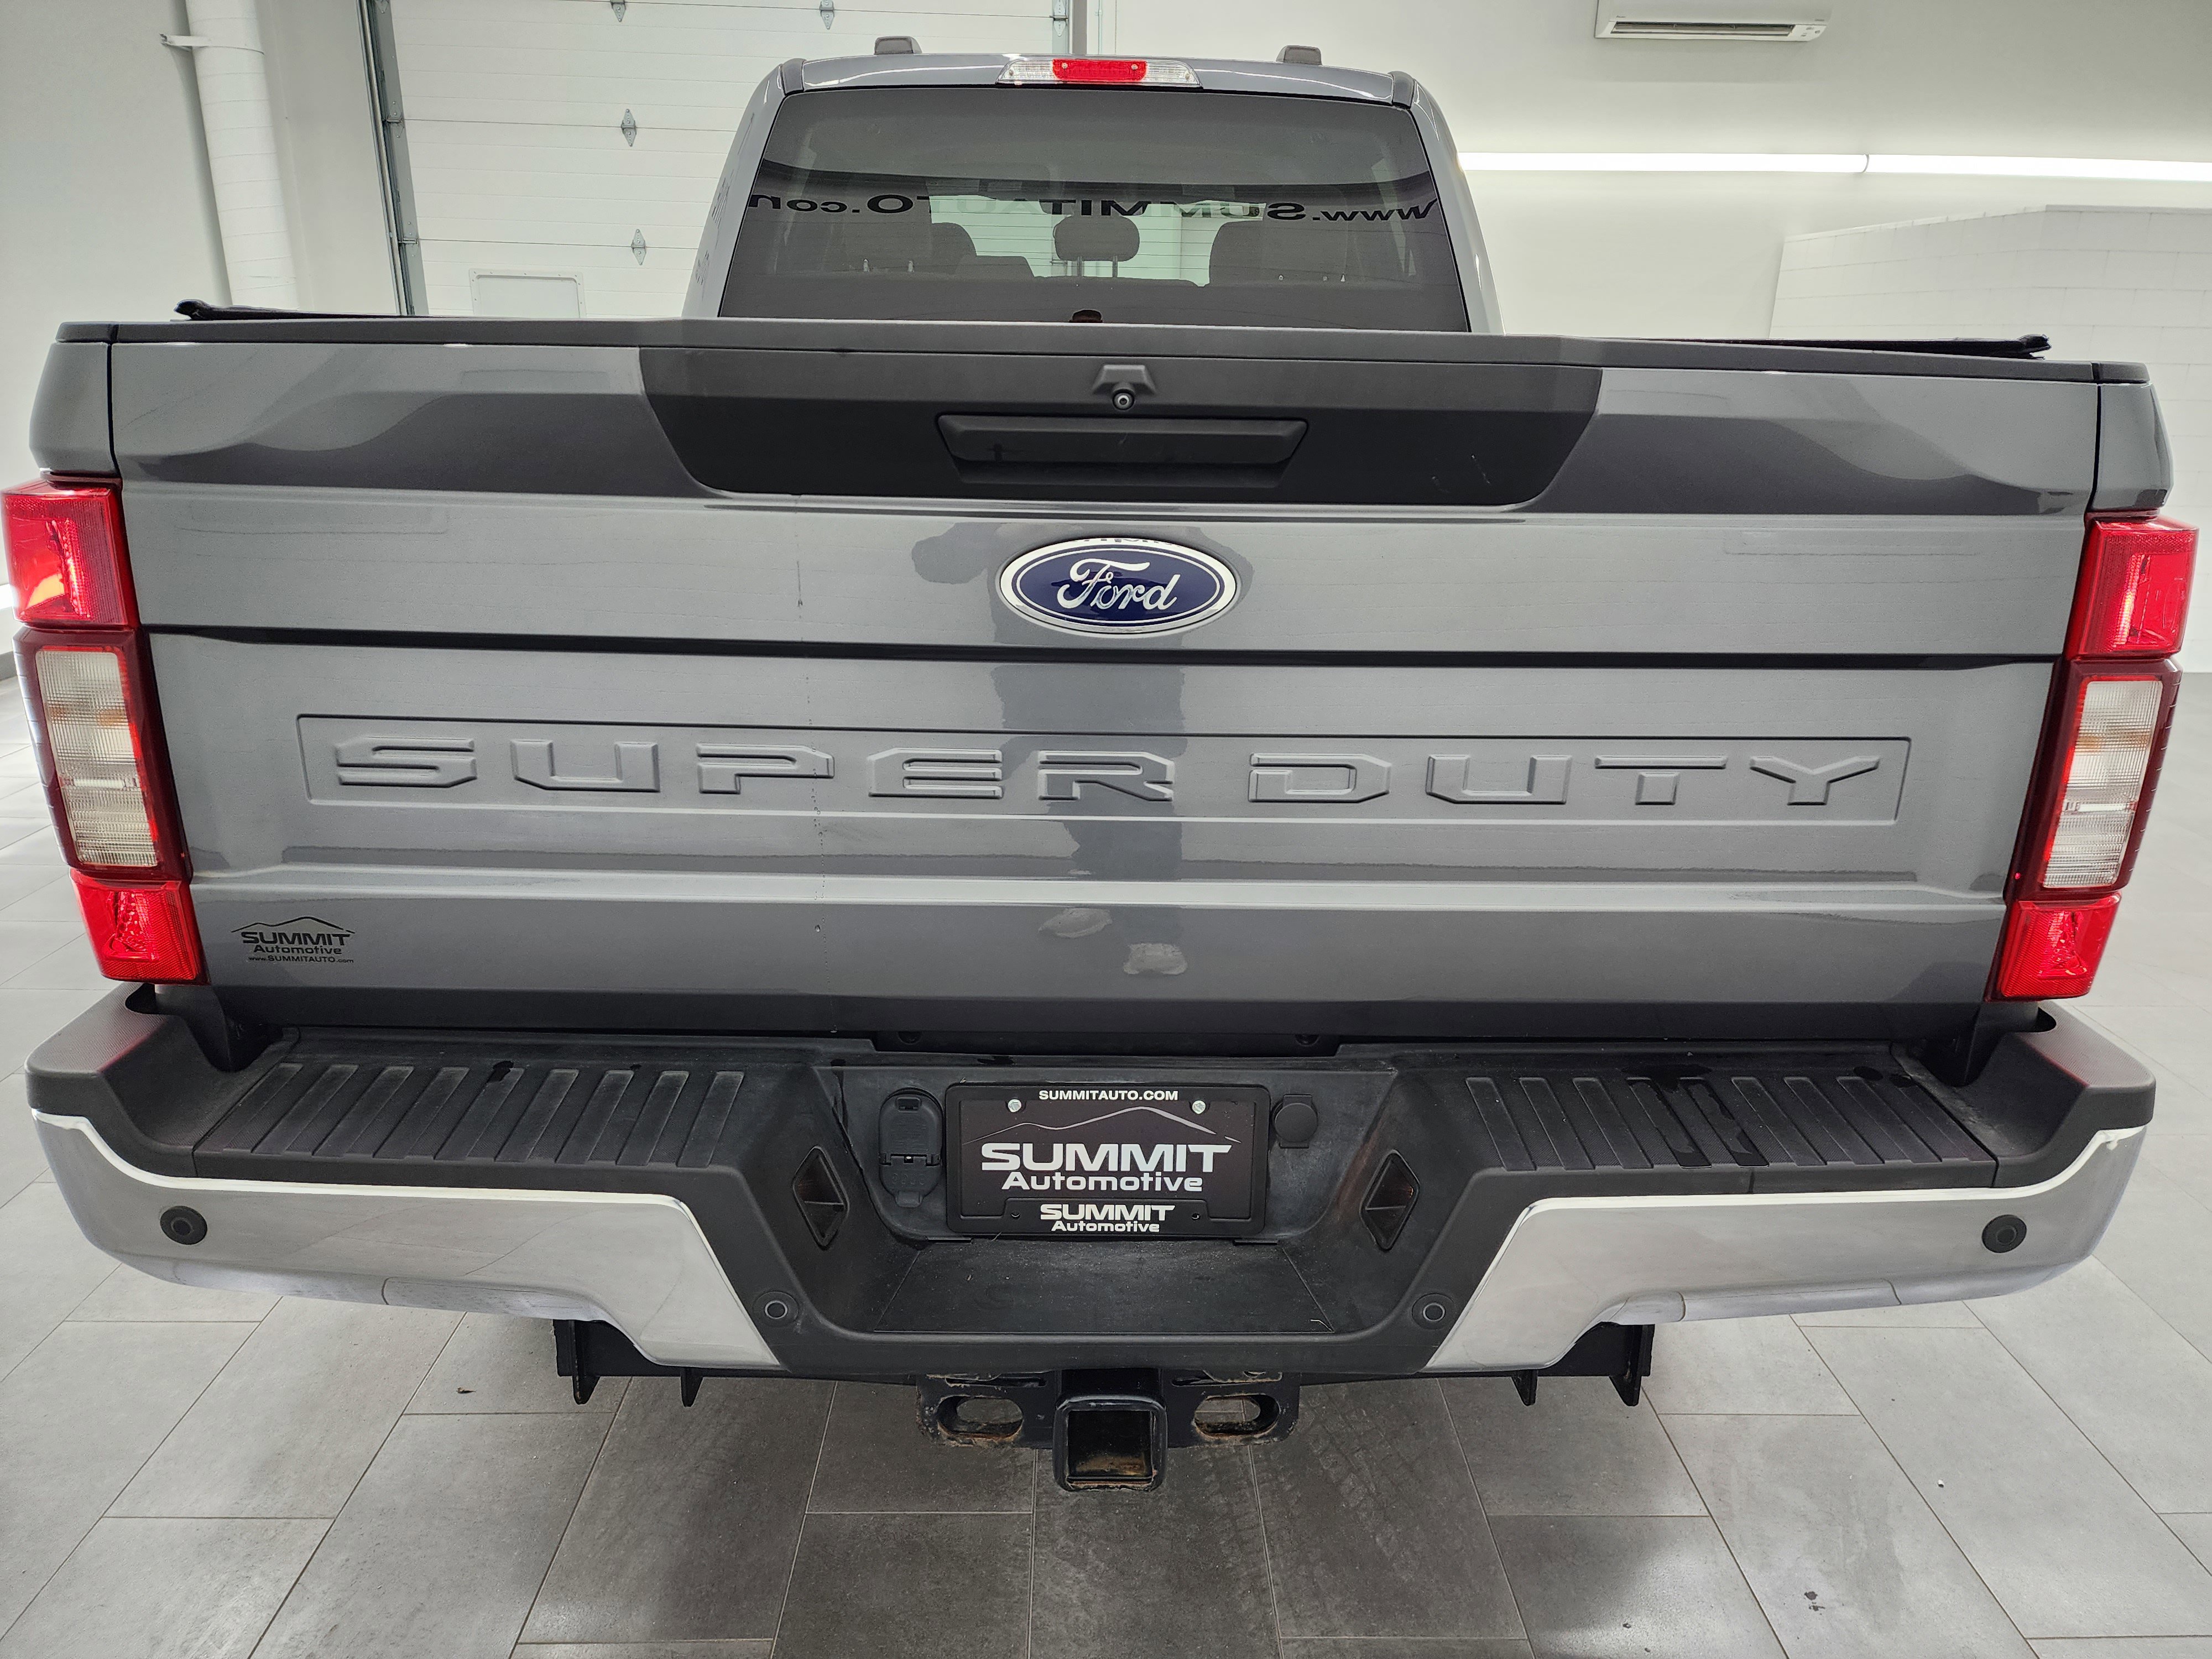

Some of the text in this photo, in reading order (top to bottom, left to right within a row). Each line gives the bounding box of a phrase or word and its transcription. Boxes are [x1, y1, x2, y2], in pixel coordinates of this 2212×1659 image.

[1057, 557, 1181, 610] Ford
[334, 735, 1881, 806] SUPER DUTY
[241, 931, 351, 946] SUMMIT
[253, 944, 342, 954] Automotive
[248, 955, 354, 963] www.SUMMITAUTO.com
[1039, 1089, 1178, 1101] SUMMITAUTO.COM
[981, 1142, 1232, 1172] SUMMIT
[1001, 1171, 1203, 1192] Automotive
[1040, 1203, 1176, 1221] SUMMIT
[1051, 1220, 1160, 1233] Automotive
